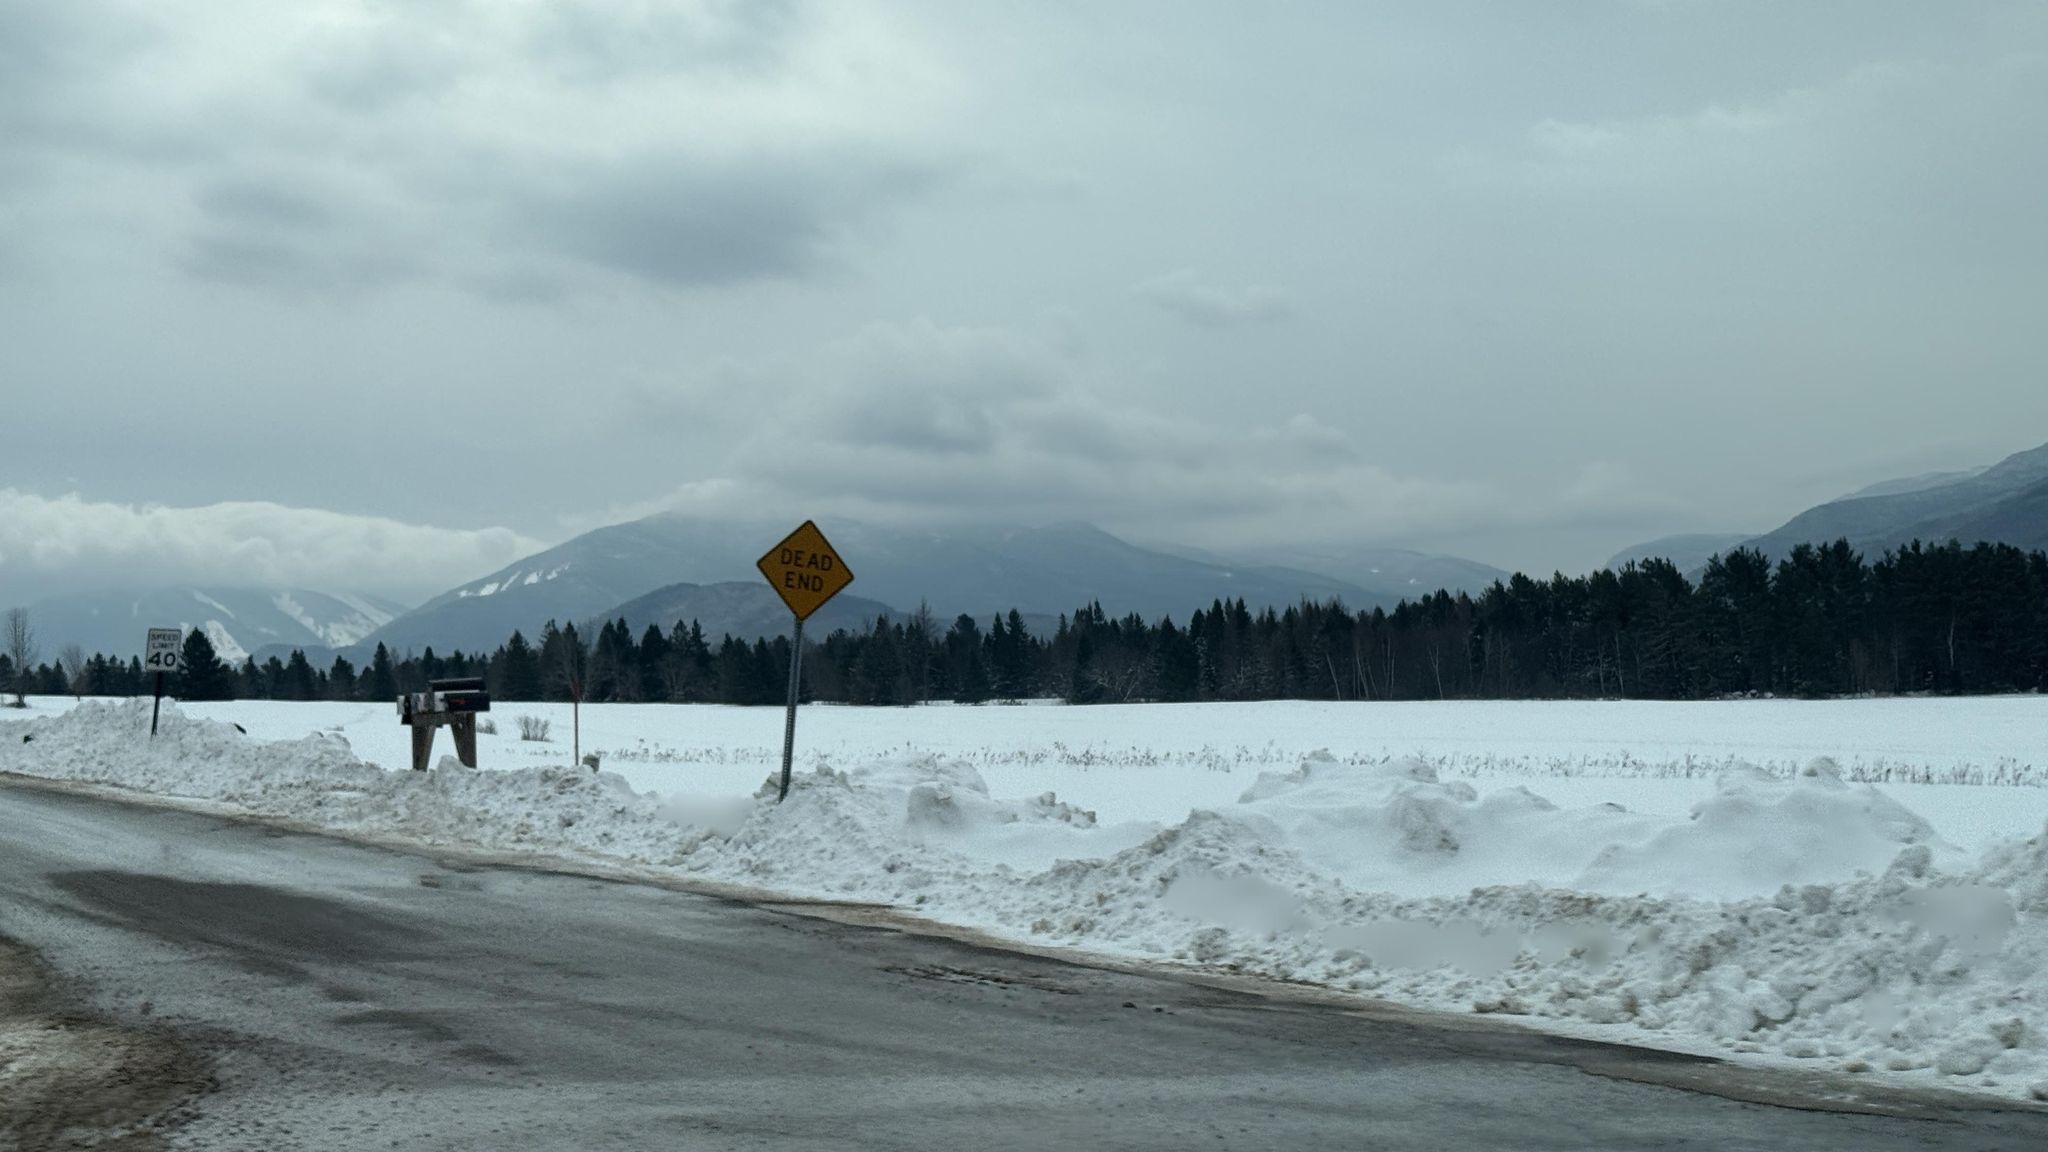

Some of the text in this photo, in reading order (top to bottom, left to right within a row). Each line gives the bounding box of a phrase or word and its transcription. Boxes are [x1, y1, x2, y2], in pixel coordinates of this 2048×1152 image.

[781, 548, 833, 571] DEAD
[785, 571, 823, 592] END
[149, 652, 176, 667] 40
